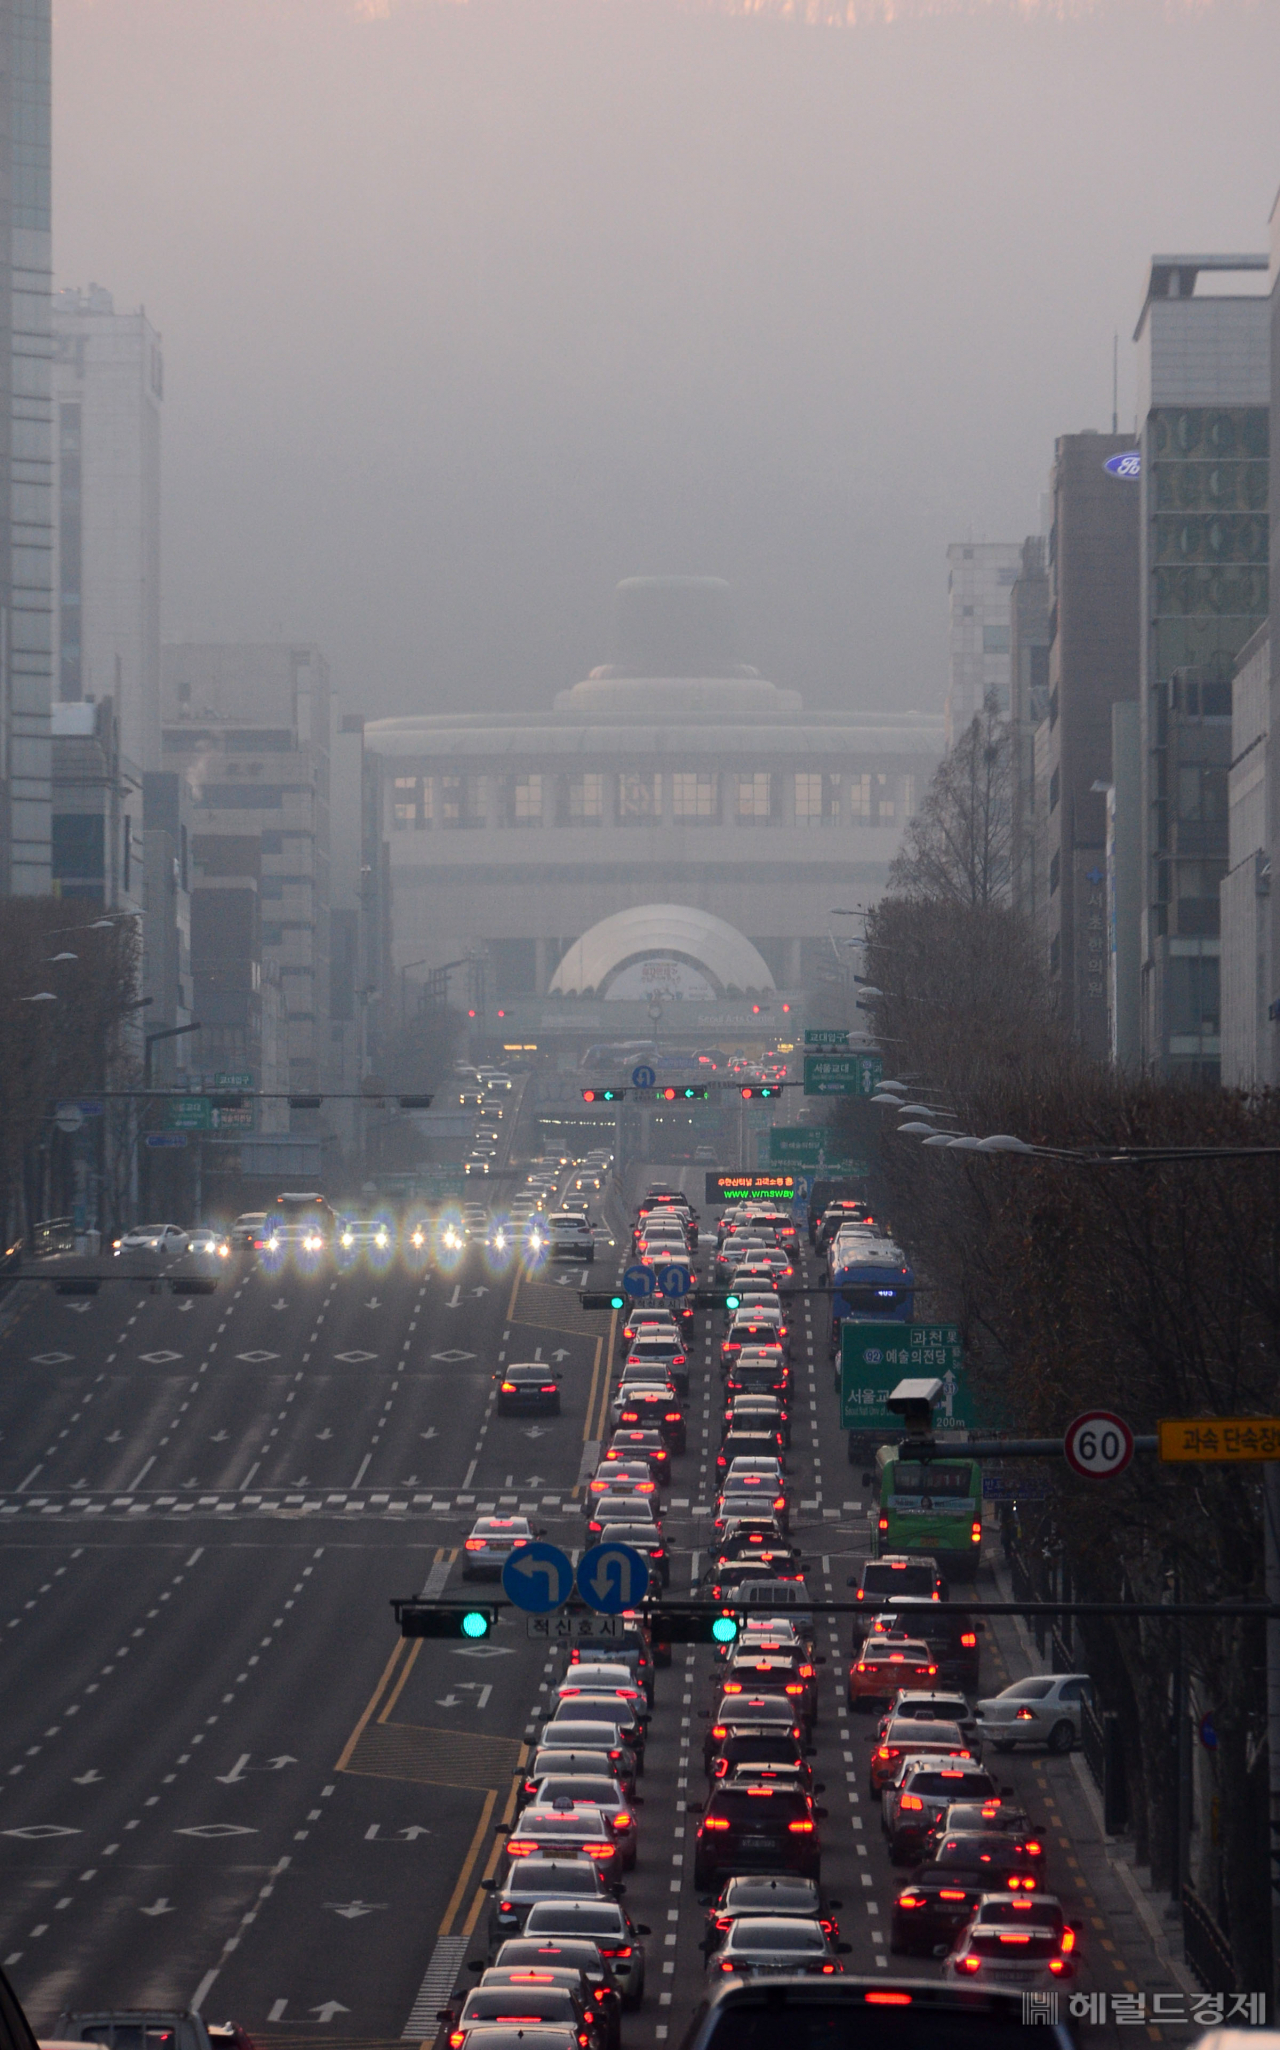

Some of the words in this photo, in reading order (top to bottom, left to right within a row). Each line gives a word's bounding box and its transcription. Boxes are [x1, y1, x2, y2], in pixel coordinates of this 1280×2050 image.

[1088, 893, 1103, 997] 서초한의원
[698, 1014, 724, 1023] Seoul
[726, 1014, 745, 1023] Arts
[746, 1014, 776, 1023] Center
[810, 1032, 846, 1043] 교대입구
[814, 1063, 850, 1073] 서울교대
[219, 1076, 249, 1085] 교대입구
[724, 1190, 794, 1199] www.wmsway
[913, 1330, 943, 1347] 과천
[867, 1350, 881, 1362] 92
[886, 1349, 947, 1365] 예술의전당
[936, 1417, 965, 1428] 200m
[1078, 1431, 1120, 1461] 60
[1183, 1427, 1219, 1453] 과속
[1222, 1426, 1280, 1454] 단속장
[533, 1619, 617, 1637] 적신호시
